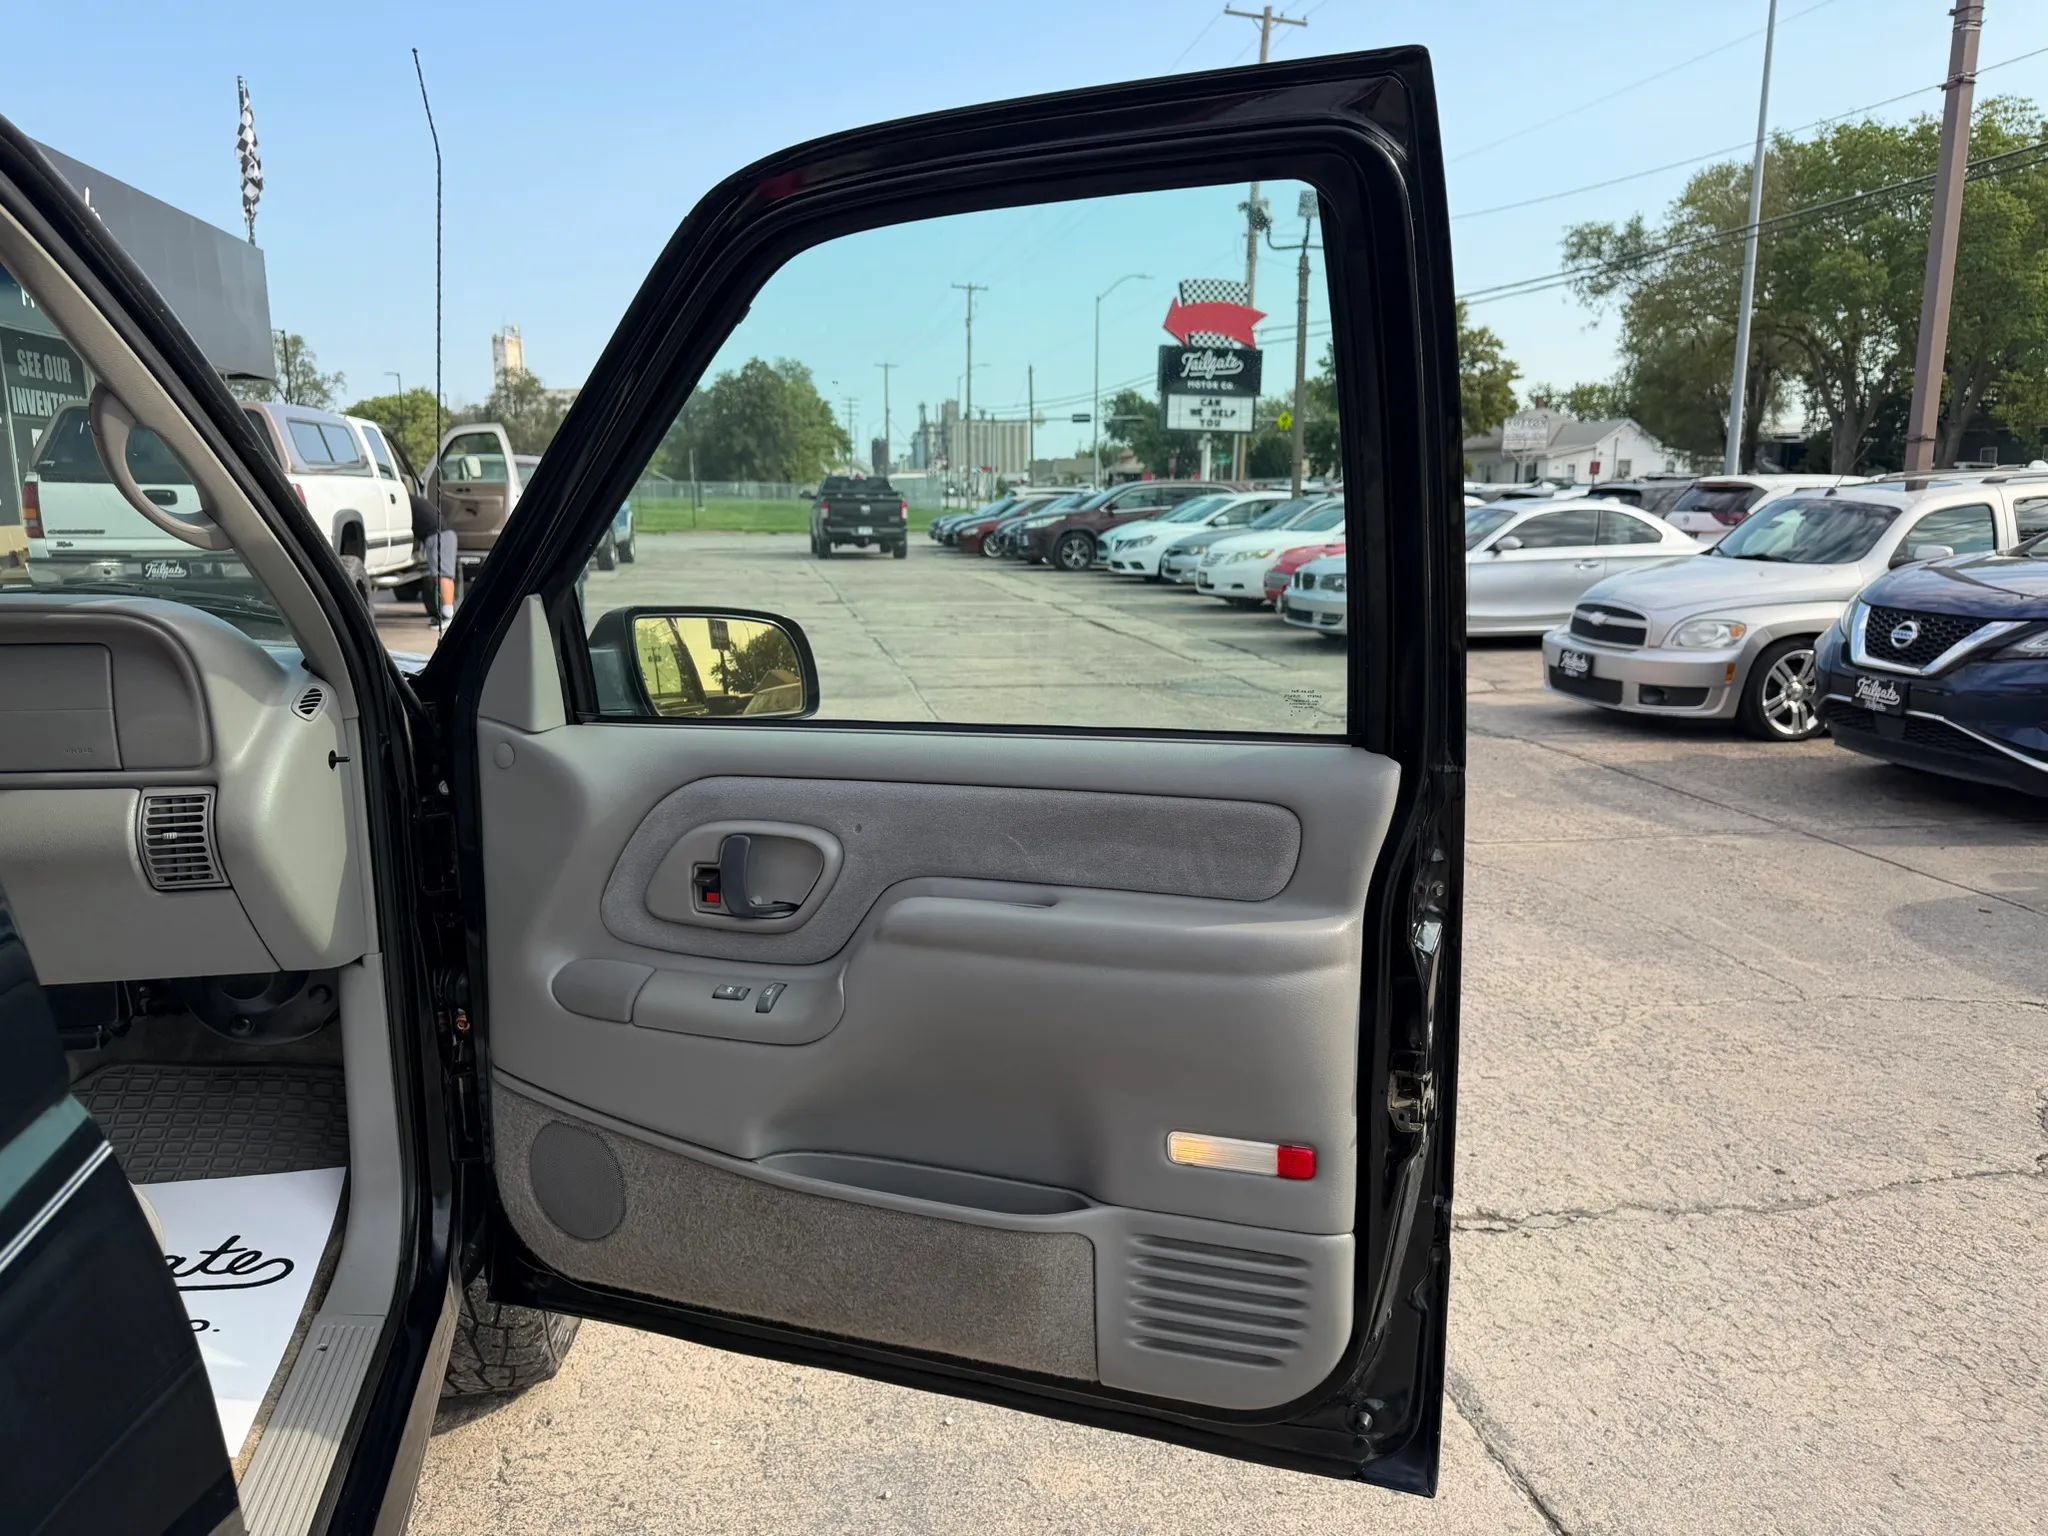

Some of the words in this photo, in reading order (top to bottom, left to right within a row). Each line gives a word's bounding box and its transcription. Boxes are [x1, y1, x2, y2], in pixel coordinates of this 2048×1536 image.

[17, 349, 43, 379] SEE
[43, 354, 72, 384] OUR
[1180, 349, 1245, 379] Tailgate
[1187, 380, 1219, 390] MOTOR
[10, 386, 82, 417] INVENT
[1200, 398, 1221, 407] CAN
[1190, 408, 1203, 417] WE
[1211, 409, 1236, 418] HELP
[1200, 419, 1221, 427] YOU
[145, 562, 188, 580] Tailgate
[1855, 676, 1900, 706] Tailgate
